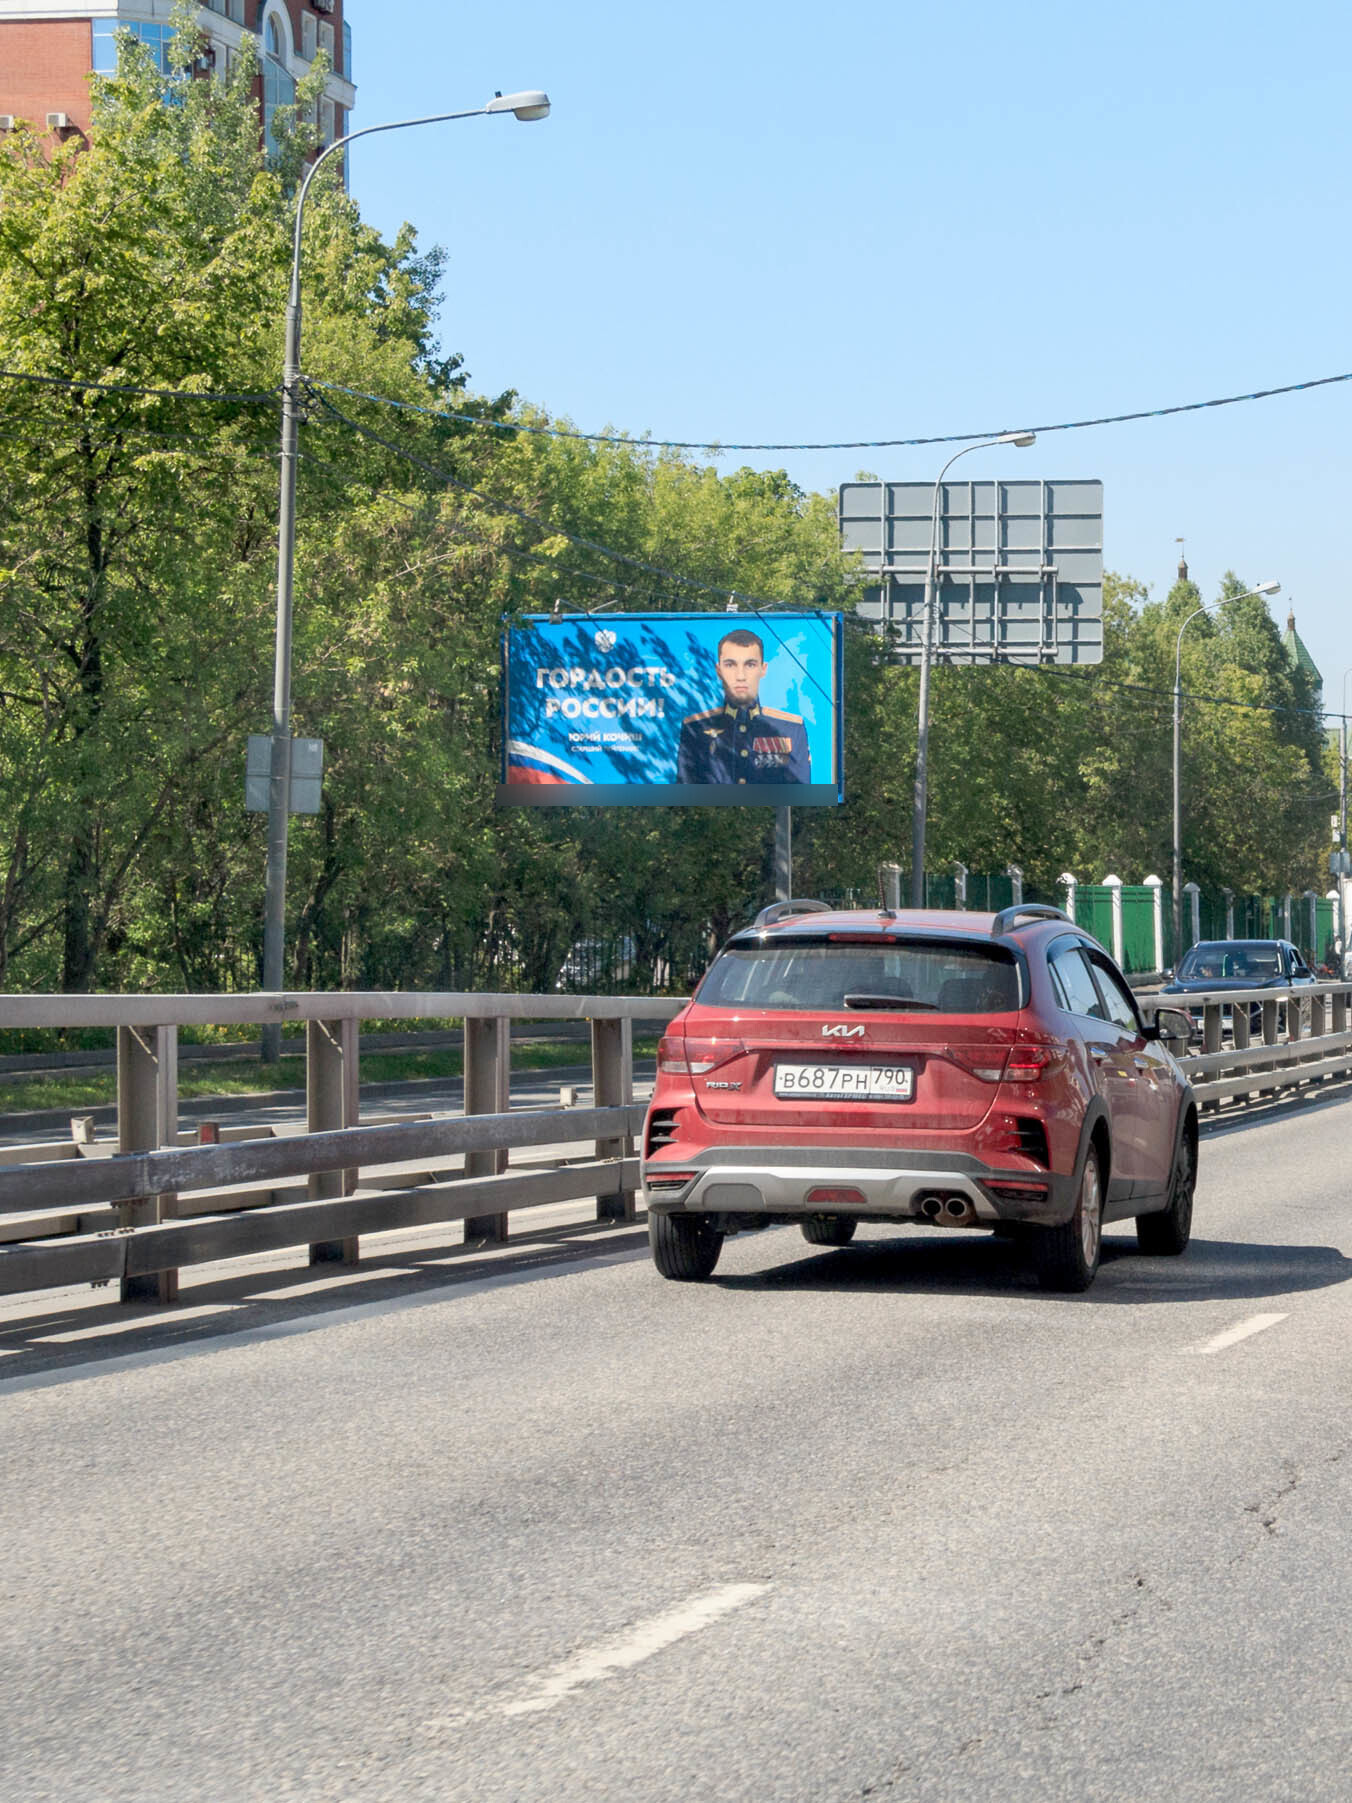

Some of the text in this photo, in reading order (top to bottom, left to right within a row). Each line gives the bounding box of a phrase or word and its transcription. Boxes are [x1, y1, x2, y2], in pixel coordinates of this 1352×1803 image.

[536, 667, 676, 691] ГОРДОСТЬ
[545, 697, 665, 719] РОССИИ!
[822, 1024, 865, 1037] KIA
